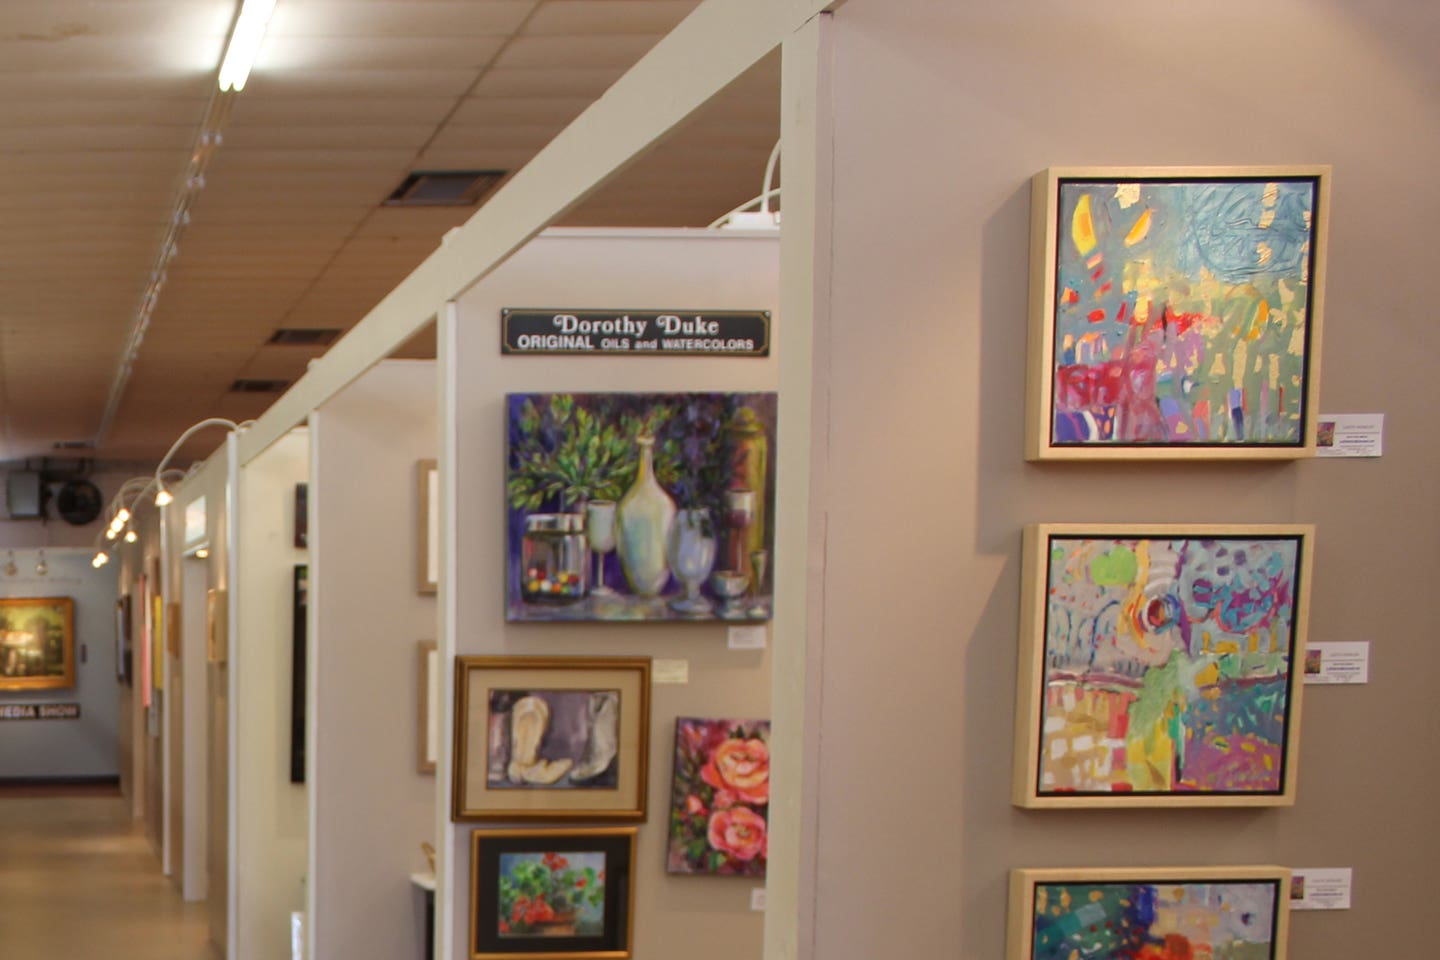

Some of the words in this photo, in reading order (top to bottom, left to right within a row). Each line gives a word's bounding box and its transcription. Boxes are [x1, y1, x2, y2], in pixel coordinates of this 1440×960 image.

[553, 315, 648, 337] Dorothy
[655, 315, 721, 336] Duke
[517, 334, 595, 349] ORIGINAL
[600, 337, 630, 350] OILS
[634, 337, 658, 350] and
[661, 338, 755, 351] WATERCOLORS
[38, 706, 77, 717] SHOW
